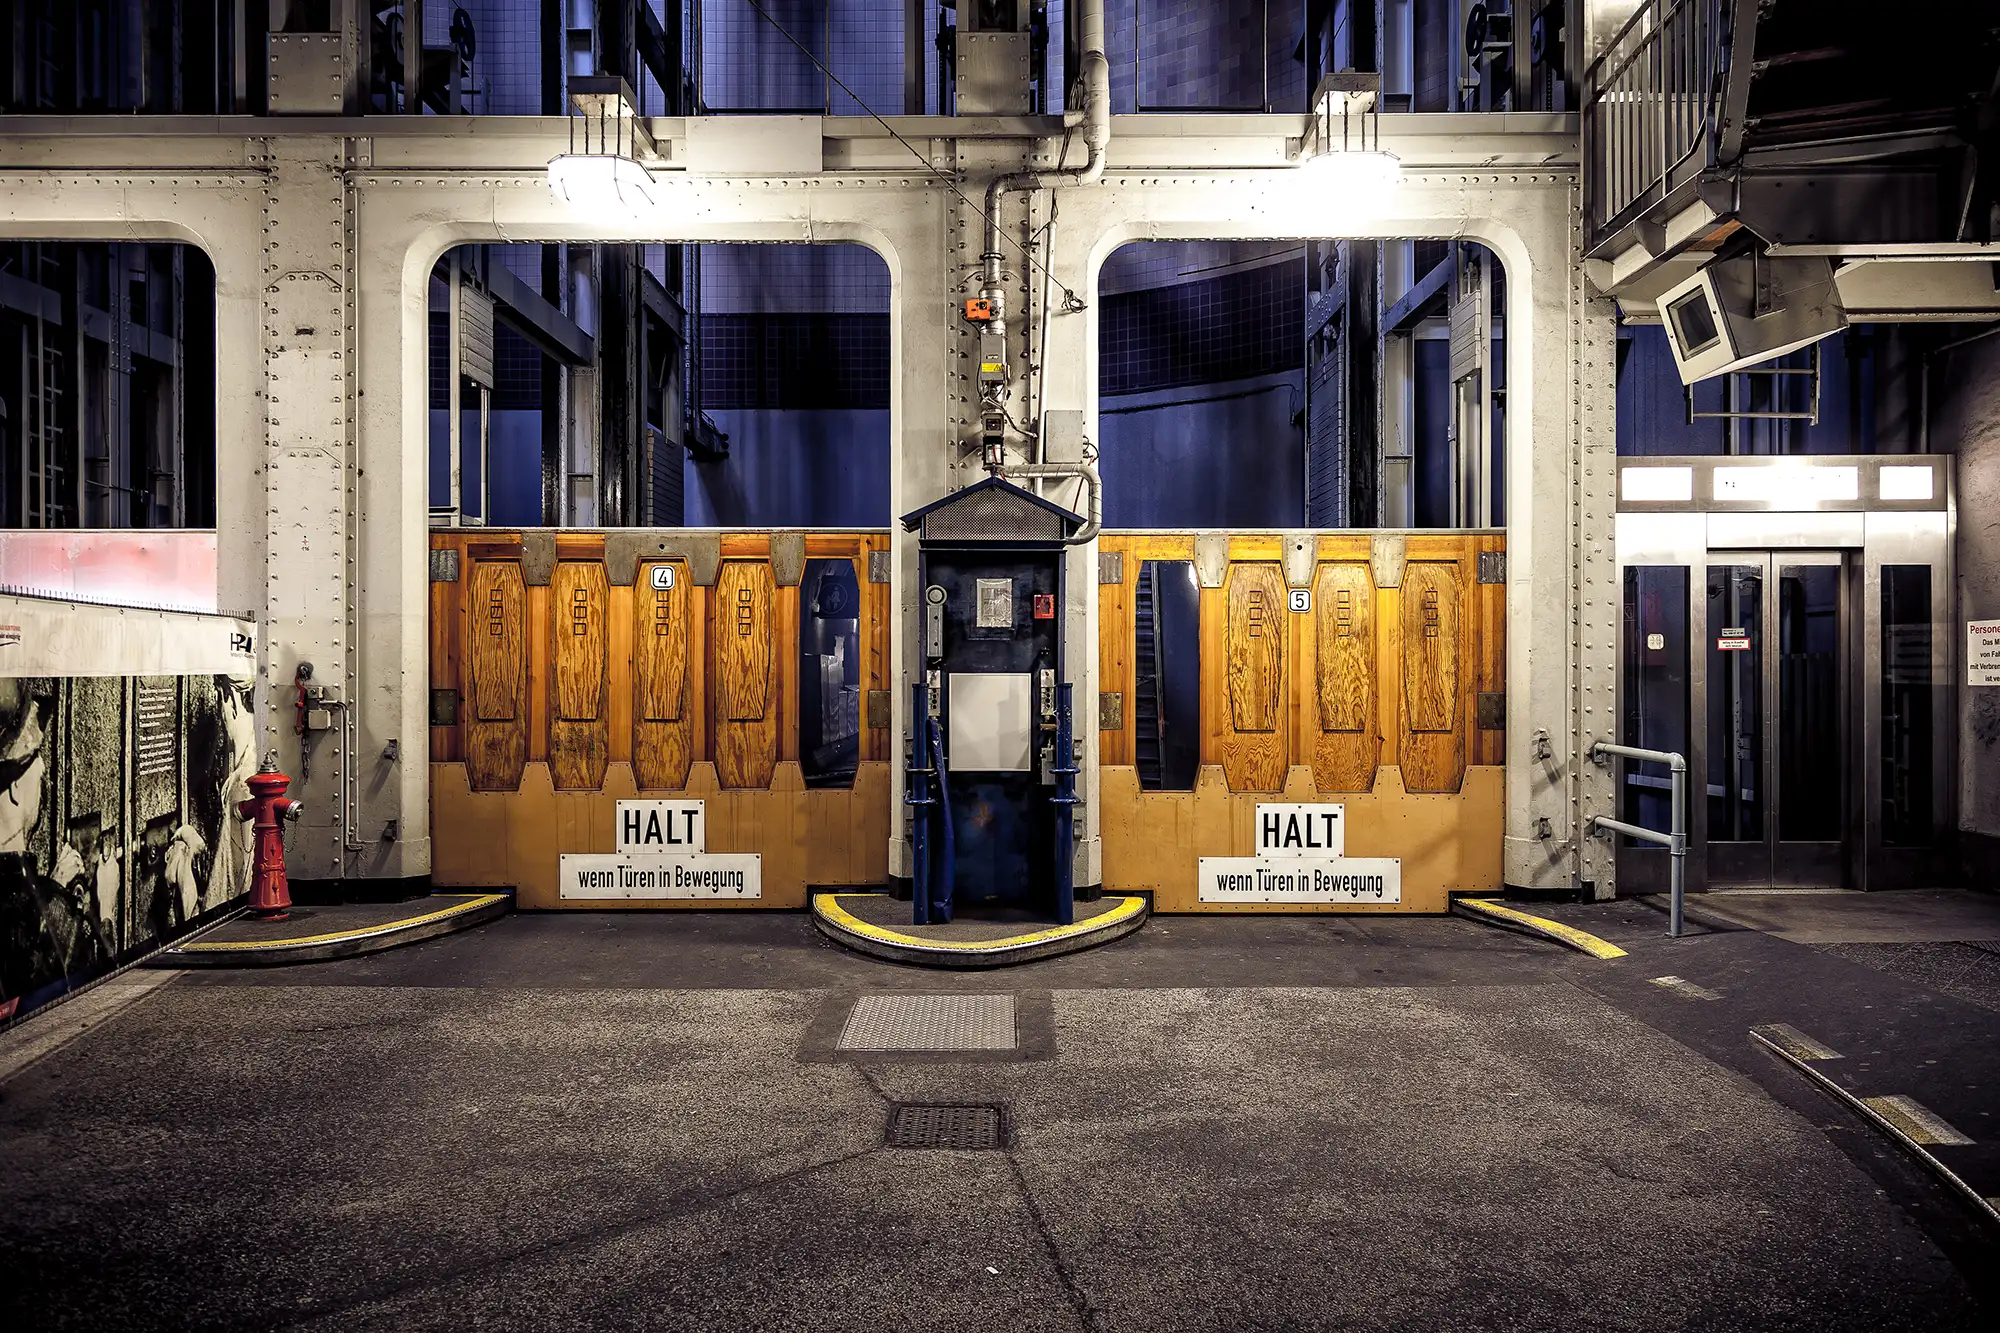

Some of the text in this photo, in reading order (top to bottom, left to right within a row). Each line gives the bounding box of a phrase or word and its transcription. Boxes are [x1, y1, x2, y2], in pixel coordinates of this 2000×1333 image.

[658, 570, 668, 585] 4
[1296, 594, 1304, 608] 5
[624, 809, 699, 845] HALT
[1263, 813, 1339, 848] HALT
[578, 865, 744, 894] wenn Türen in Bewegung
[1217, 869, 1383, 899] wenn Türen in Bewegung
